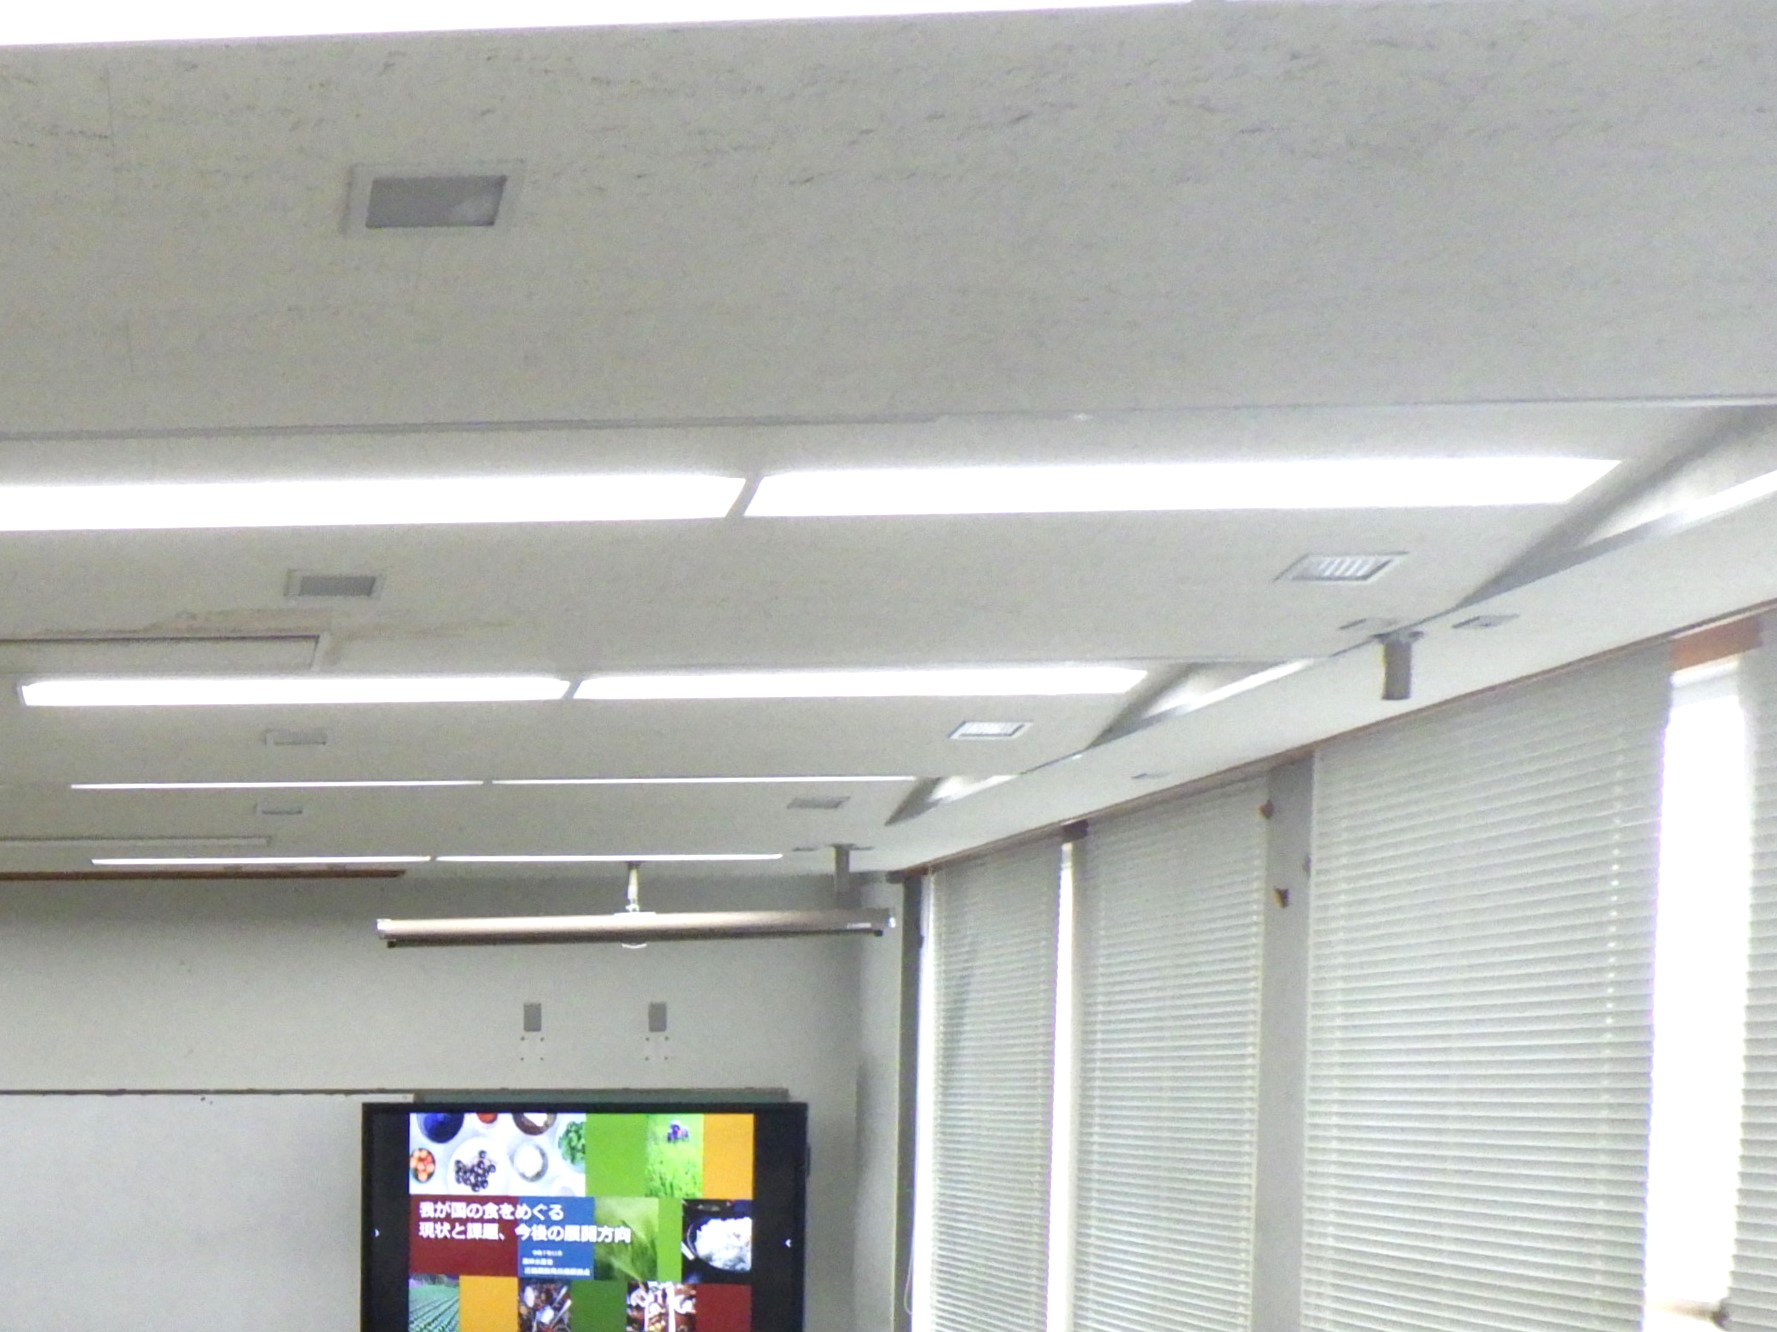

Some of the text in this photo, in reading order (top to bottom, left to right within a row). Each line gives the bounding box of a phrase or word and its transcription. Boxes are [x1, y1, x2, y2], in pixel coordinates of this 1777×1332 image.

[419, 1201, 564, 1221] 我が国の食をめぐる
[418, 1221, 632, 1244] 現状と課題、今後の展開方向
